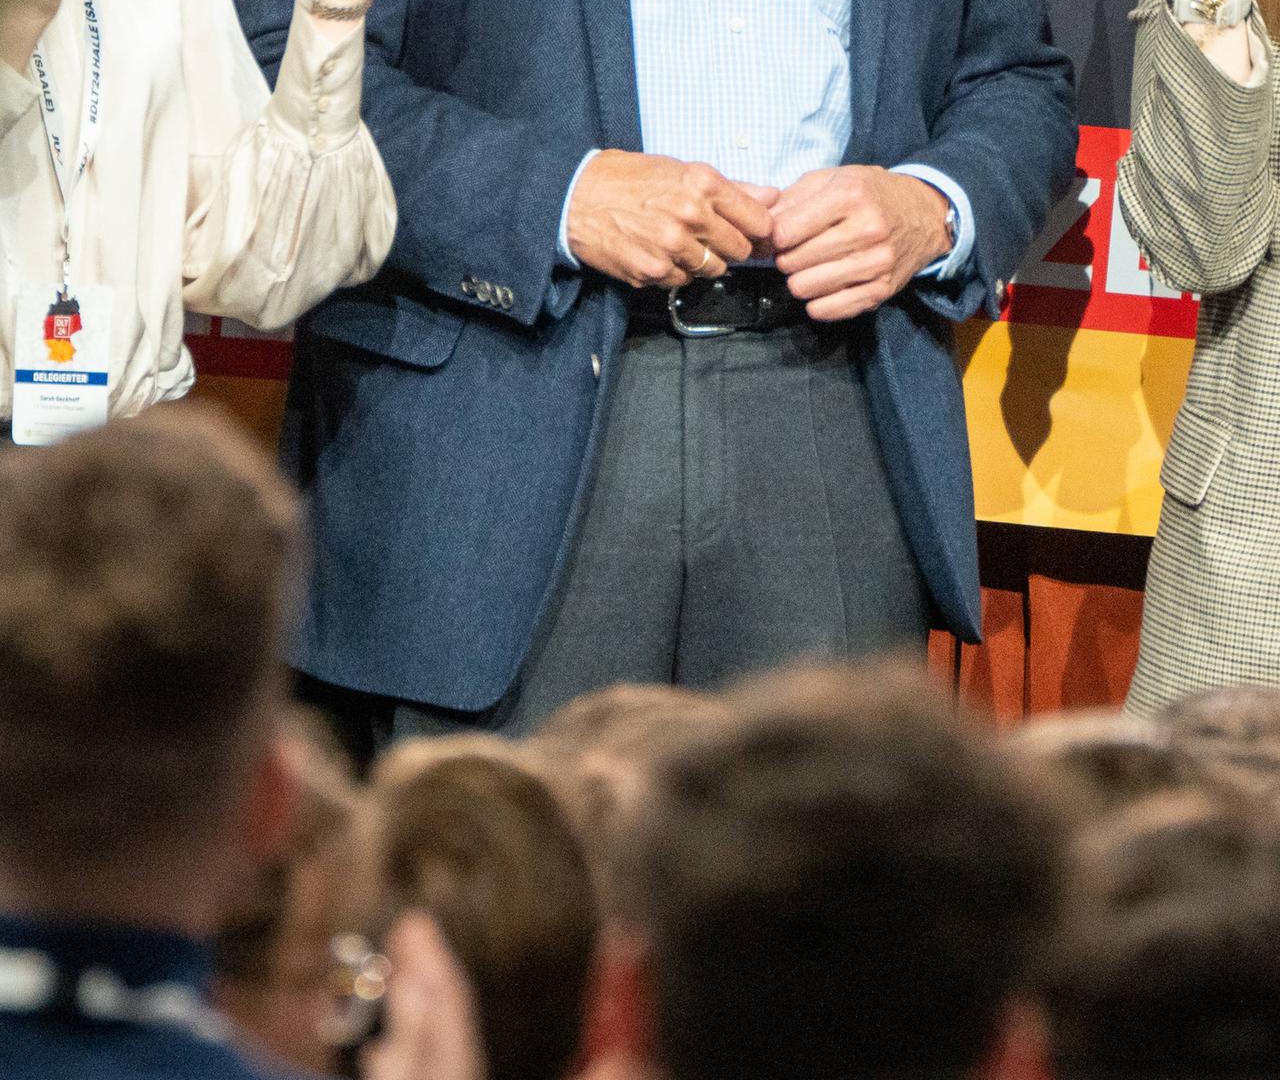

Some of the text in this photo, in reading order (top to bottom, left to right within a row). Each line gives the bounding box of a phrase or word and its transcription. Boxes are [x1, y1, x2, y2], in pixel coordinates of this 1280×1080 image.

[87, 24, 103, 70] HALLE
[32, 53, 55, 113] (SAALE)
[89, 70, 103, 125] #DLT24
[33, 372, 89, 384] DELEGIERTER
